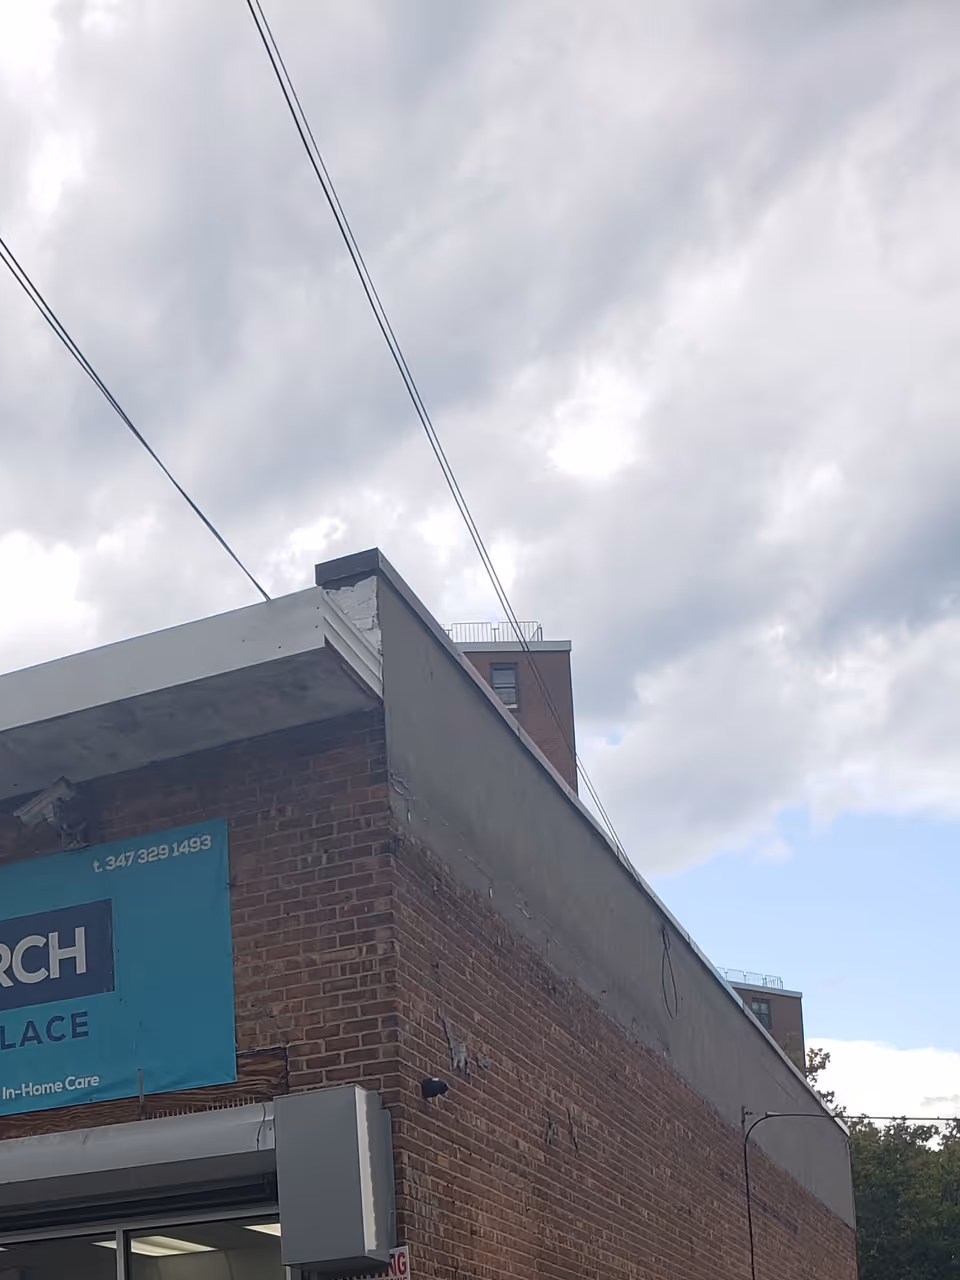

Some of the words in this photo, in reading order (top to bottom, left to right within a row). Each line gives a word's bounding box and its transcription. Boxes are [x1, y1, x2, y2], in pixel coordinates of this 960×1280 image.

[105, 851, 135, 870] 347
[137, 844, 169, 863] 329
[172, 835, 211, 856] 1493
[2, 1081, 63, 1099] In-Home
[65, 1076, 100, 1091] Care
